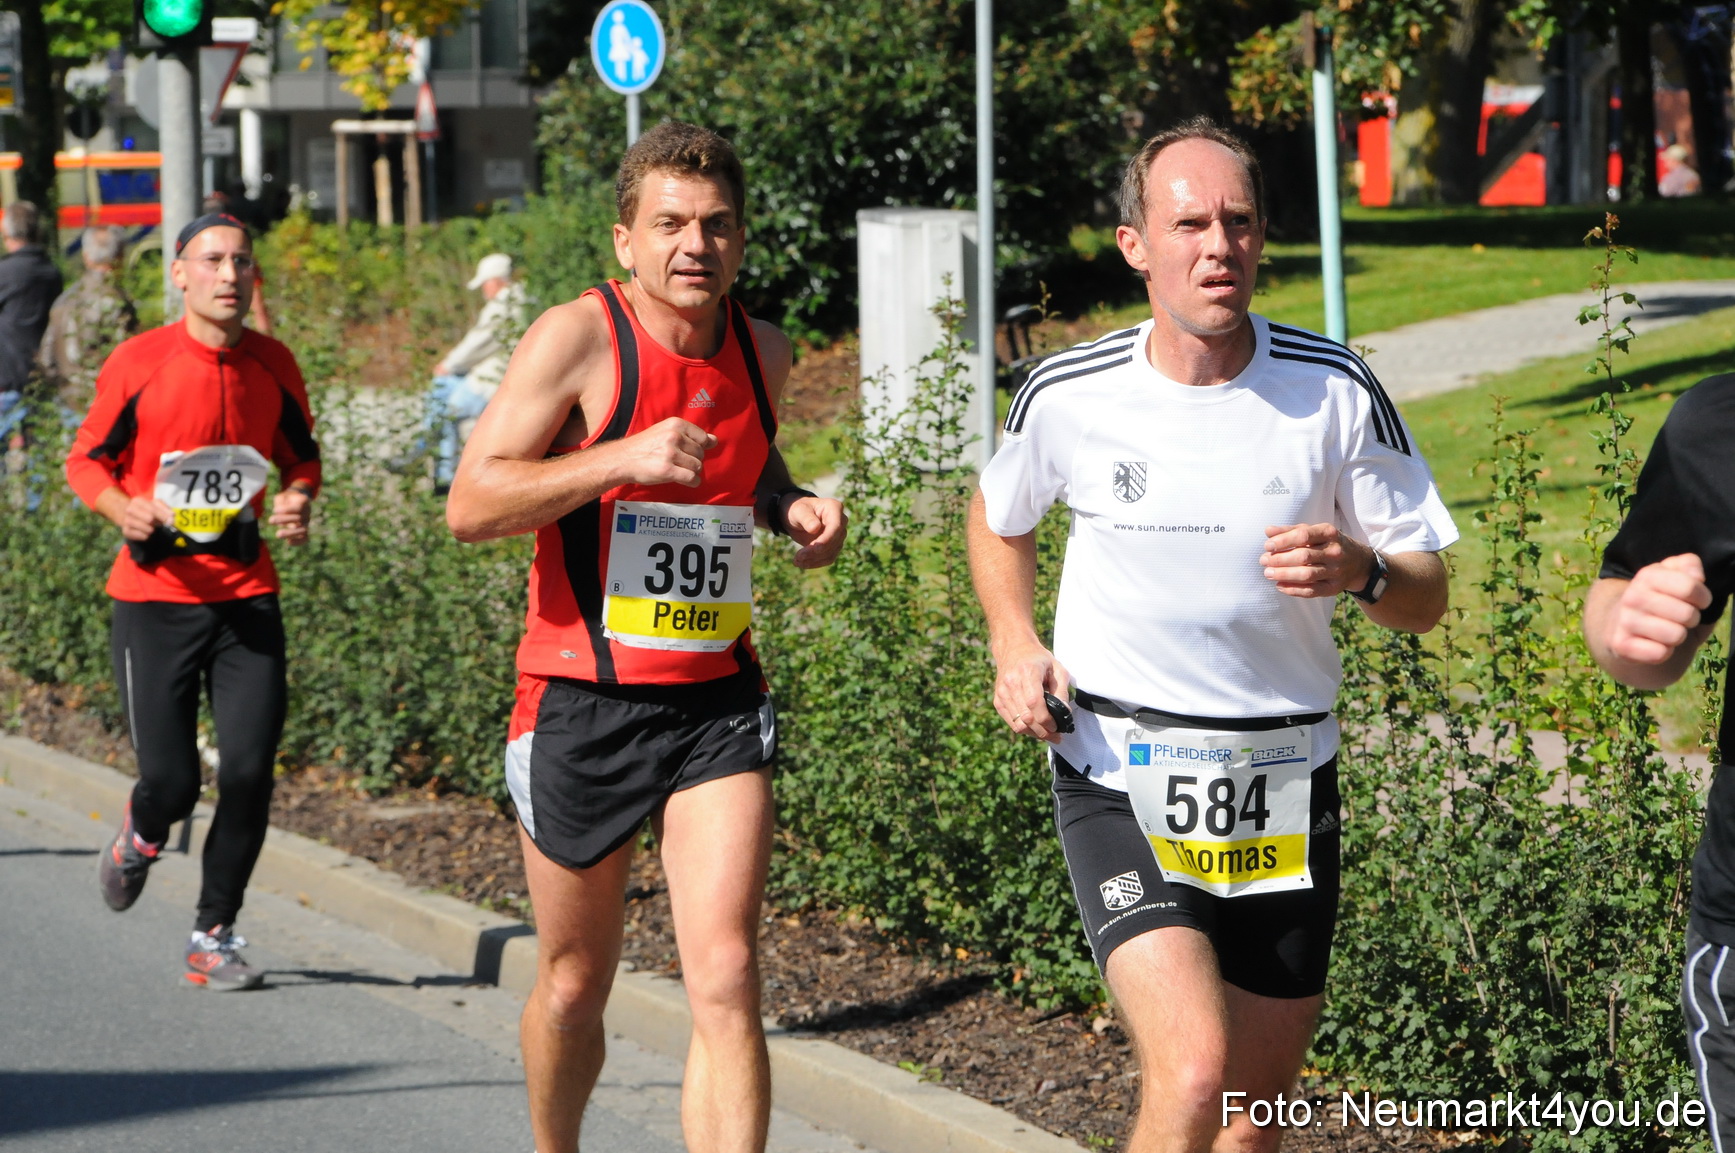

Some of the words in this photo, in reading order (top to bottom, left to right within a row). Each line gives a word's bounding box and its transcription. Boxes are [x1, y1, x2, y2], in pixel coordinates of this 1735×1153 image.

[181, 469, 243, 504] 783
[1263, 487, 1290, 495] adidas
[639, 515, 704, 530] PFLEIDERER
[719, 522, 746, 533] BOCK
[1113, 523, 1226, 534] www.sun.nuernberg.de
[638, 529, 704, 538] AKTIENGESELLSCHAFT
[644, 541, 731, 599] 395
[653, 601, 720, 631] Peter
[1154, 744, 1232, 762] PFLEIDERER
[1251, 746, 1296, 761] BOCK
[1165, 773, 1271, 837] 584
[1165, 839, 1277, 874] Thomas
